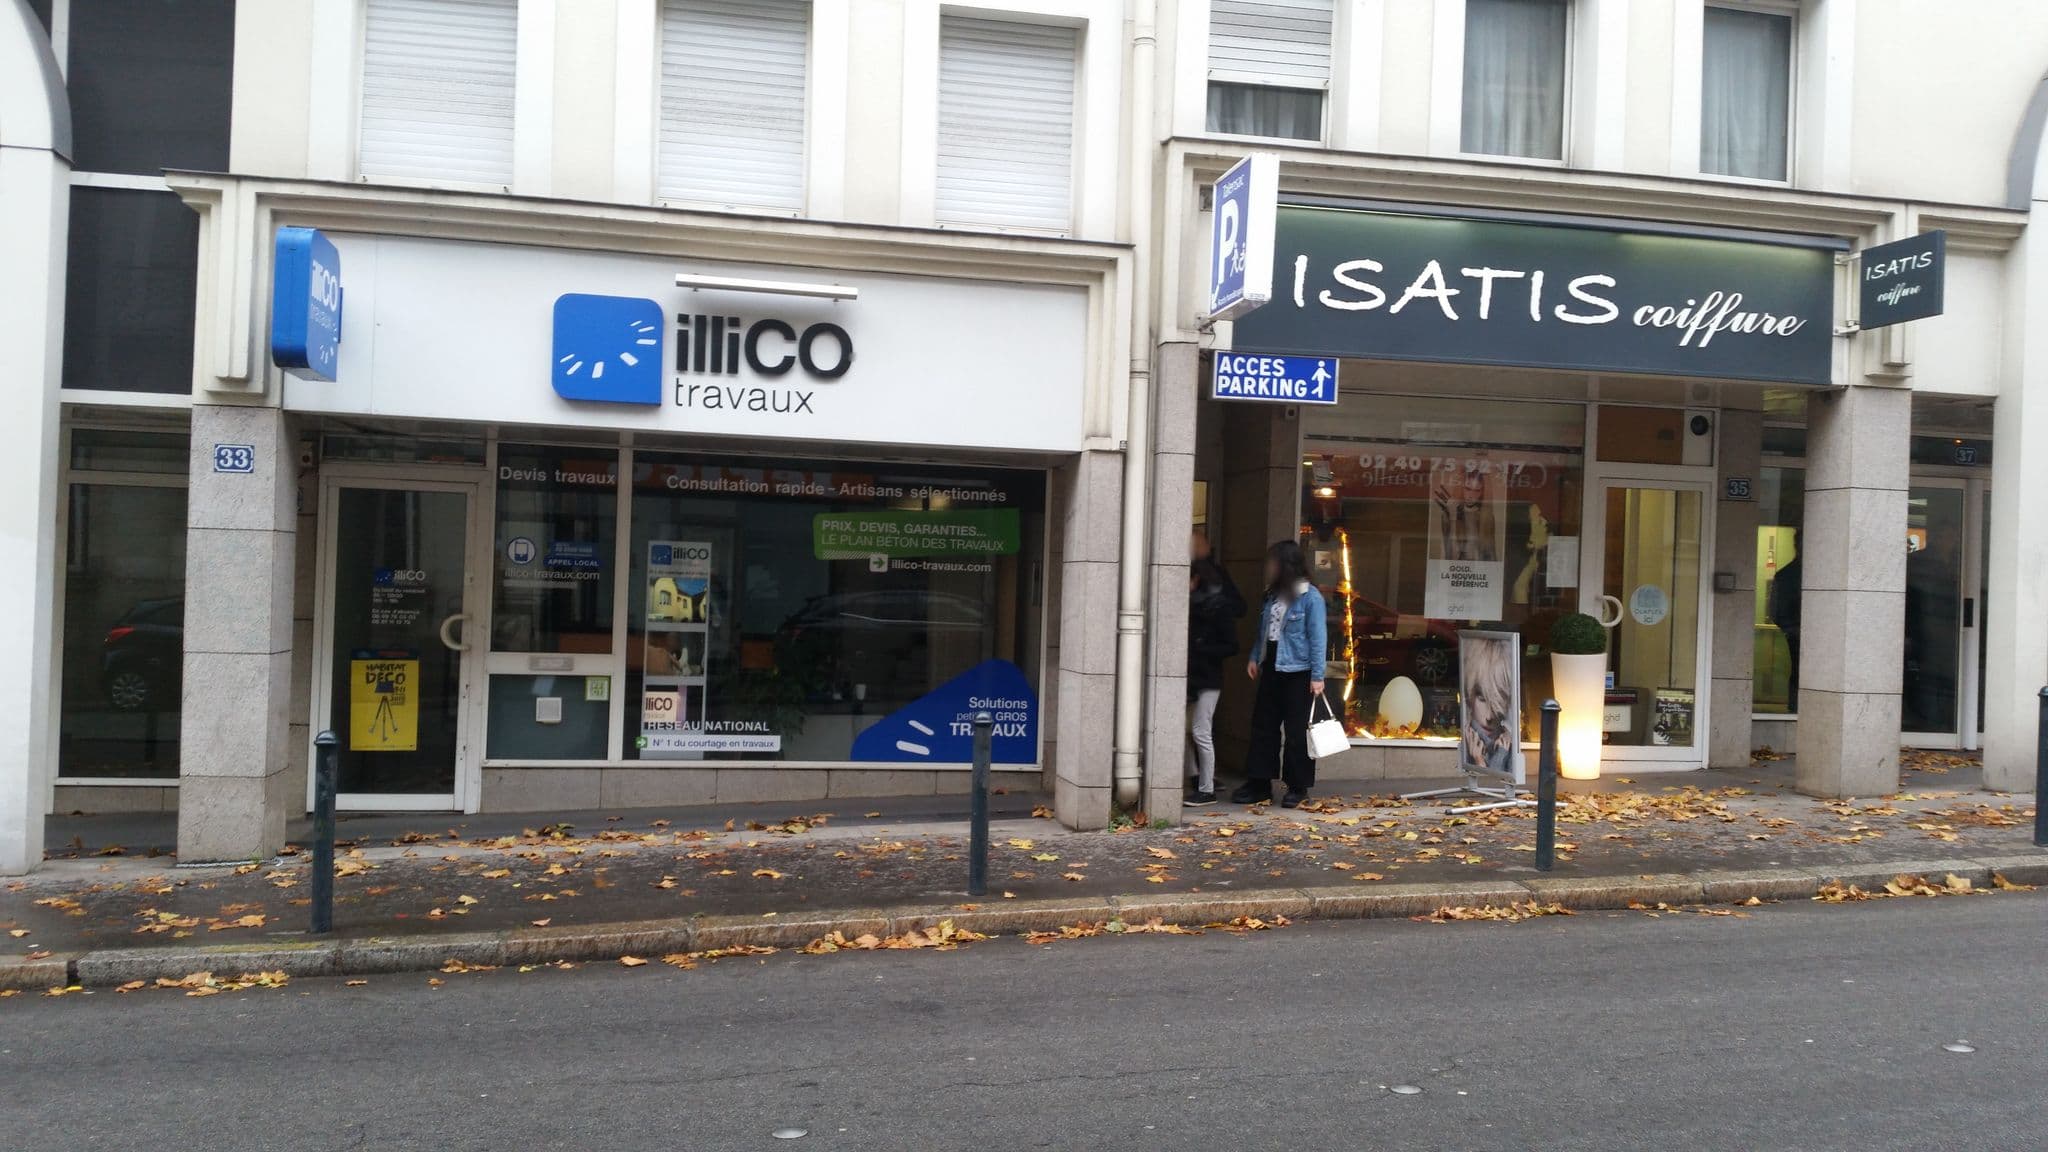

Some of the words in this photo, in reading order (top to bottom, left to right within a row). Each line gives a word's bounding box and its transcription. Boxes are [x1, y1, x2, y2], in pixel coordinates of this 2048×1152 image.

[1219, 198, 1239, 285] P
[1866, 251, 1933, 280] ISATIS
[311, 260, 339, 312] illiCO
[1877, 282, 1921, 305] coiffure
[1294, 254, 1619, 325] ISATIS
[1633, 291, 1808, 347] coiffure
[676, 313, 854, 379] illiCO
[1219, 356, 1285, 377] ACCES
[675, 377, 814, 414] travaux
[1217, 375, 1307, 398] PARKING
[219, 448, 249, 468] 33
[1359, 454, 1386, 469] 02
[1394, 455, 1422, 470] 40
[1430, 457, 1457, 472] 75
[1959, 450, 1974, 462] 37
[499, 466, 547, 482] Devis
[555, 469, 617, 485] travaux
[666, 475, 769, 493] Consultation
[775, 480, 825, 496] rapide
[839, 482, 903, 498] Artisans
[910, 486, 1007, 502] sélectionnés
[1730, 481, 1748, 495] 35
[822, 520, 856, 532] PRIX,
[860, 522, 900, 535] DEVIS,
[903, 524, 987, 537] GARANTIES...
[822, 534, 837, 545] LE
[840, 535, 872, 546] PLAN
[921, 538, 946, 549] DES
[950, 539, 1004, 551] TRAVAUX
[673, 547, 709, 560] illiCO
[891, 560, 992, 573] illico-travaux.com
[969, 697, 1028, 709] Solutions
[705, 721, 770, 731] NATIONAL
[996, 712, 1027, 722] GROS
[949, 722, 1027, 737] TRAUX
[688, 740, 727, 749] courtage
[743, 740, 774, 748] travaux
